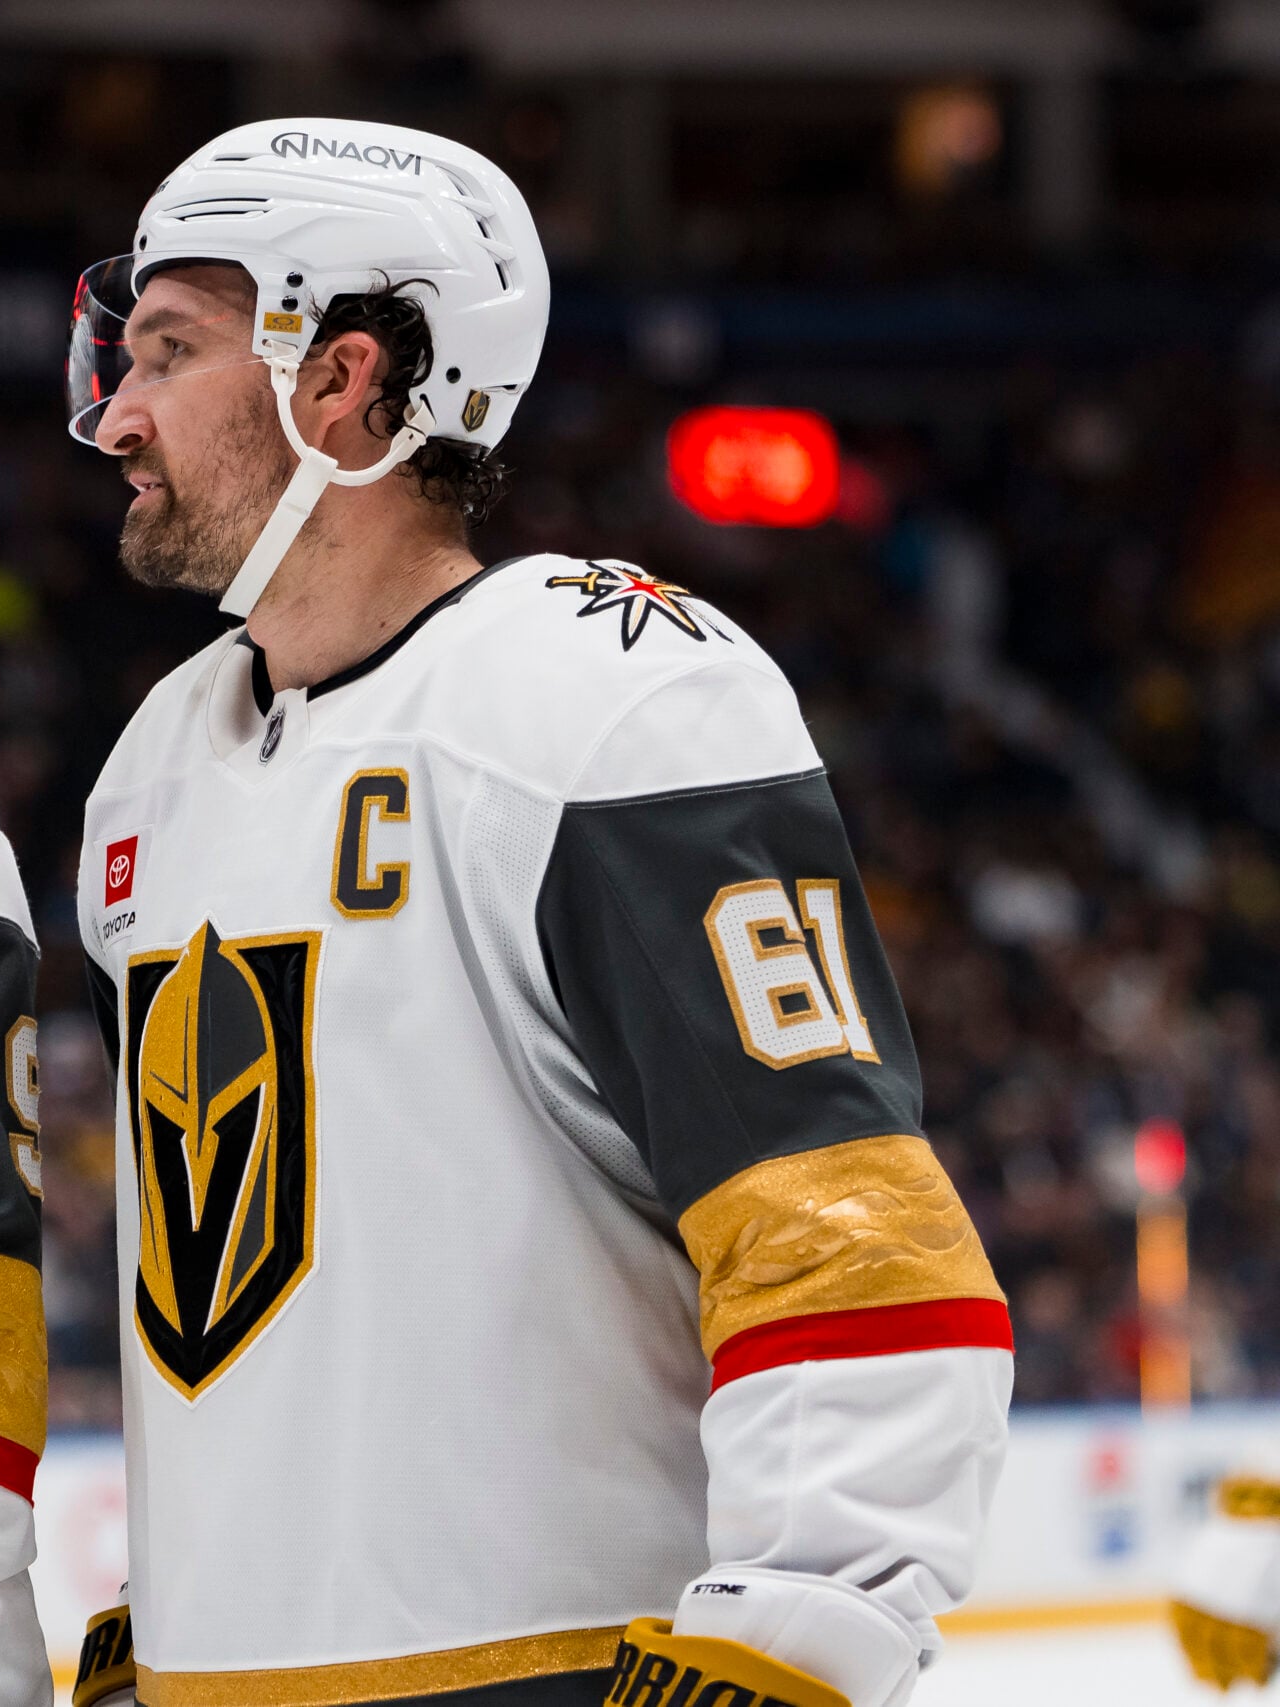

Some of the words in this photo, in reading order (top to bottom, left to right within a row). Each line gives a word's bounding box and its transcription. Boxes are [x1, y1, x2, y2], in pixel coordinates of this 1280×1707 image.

[312, 138, 421, 176] NAQVI
[330, 767, 411, 921] C
[703, 878, 882, 1071] 61
[691, 1582, 748, 1596] STONE
